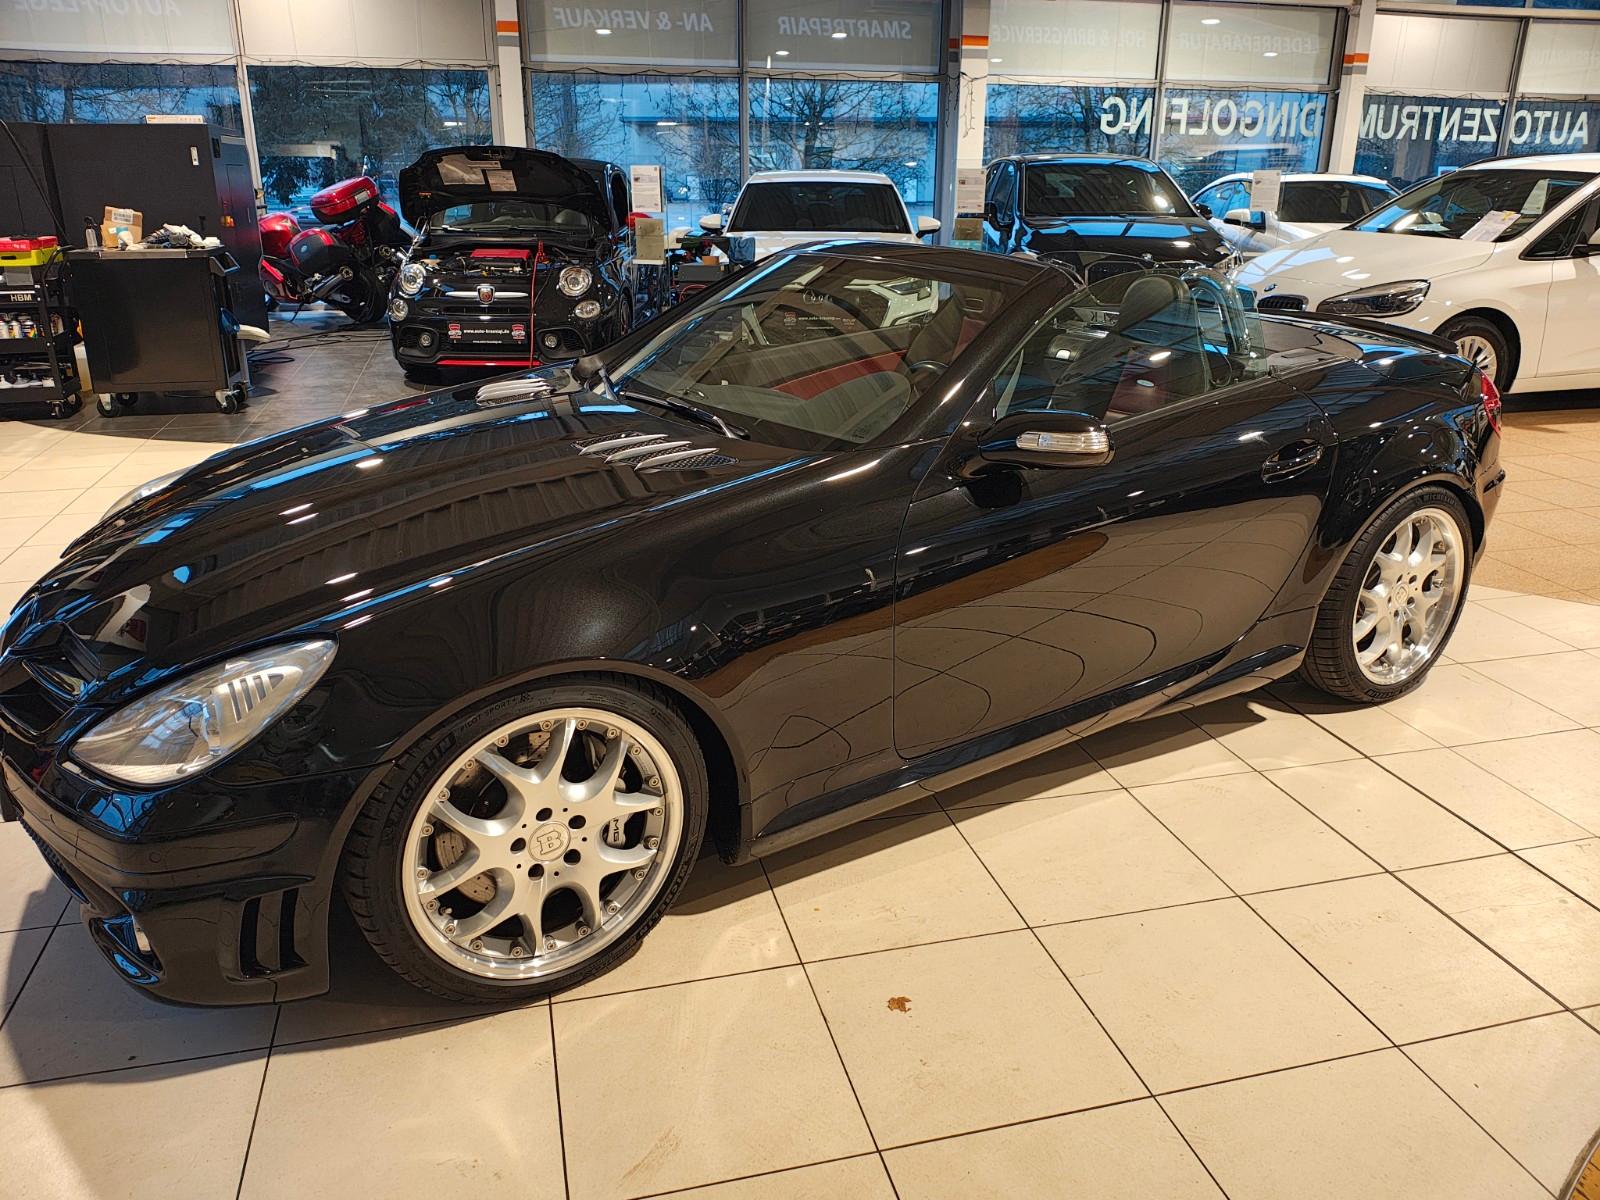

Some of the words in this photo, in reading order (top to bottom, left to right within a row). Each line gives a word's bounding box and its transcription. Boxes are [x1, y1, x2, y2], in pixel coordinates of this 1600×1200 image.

[458, 713, 482, 733] PILOT
[484, 698, 511, 716] SPORT
[387, 734, 456, 821] MICHELIN
[536, 829, 562, 856] B
